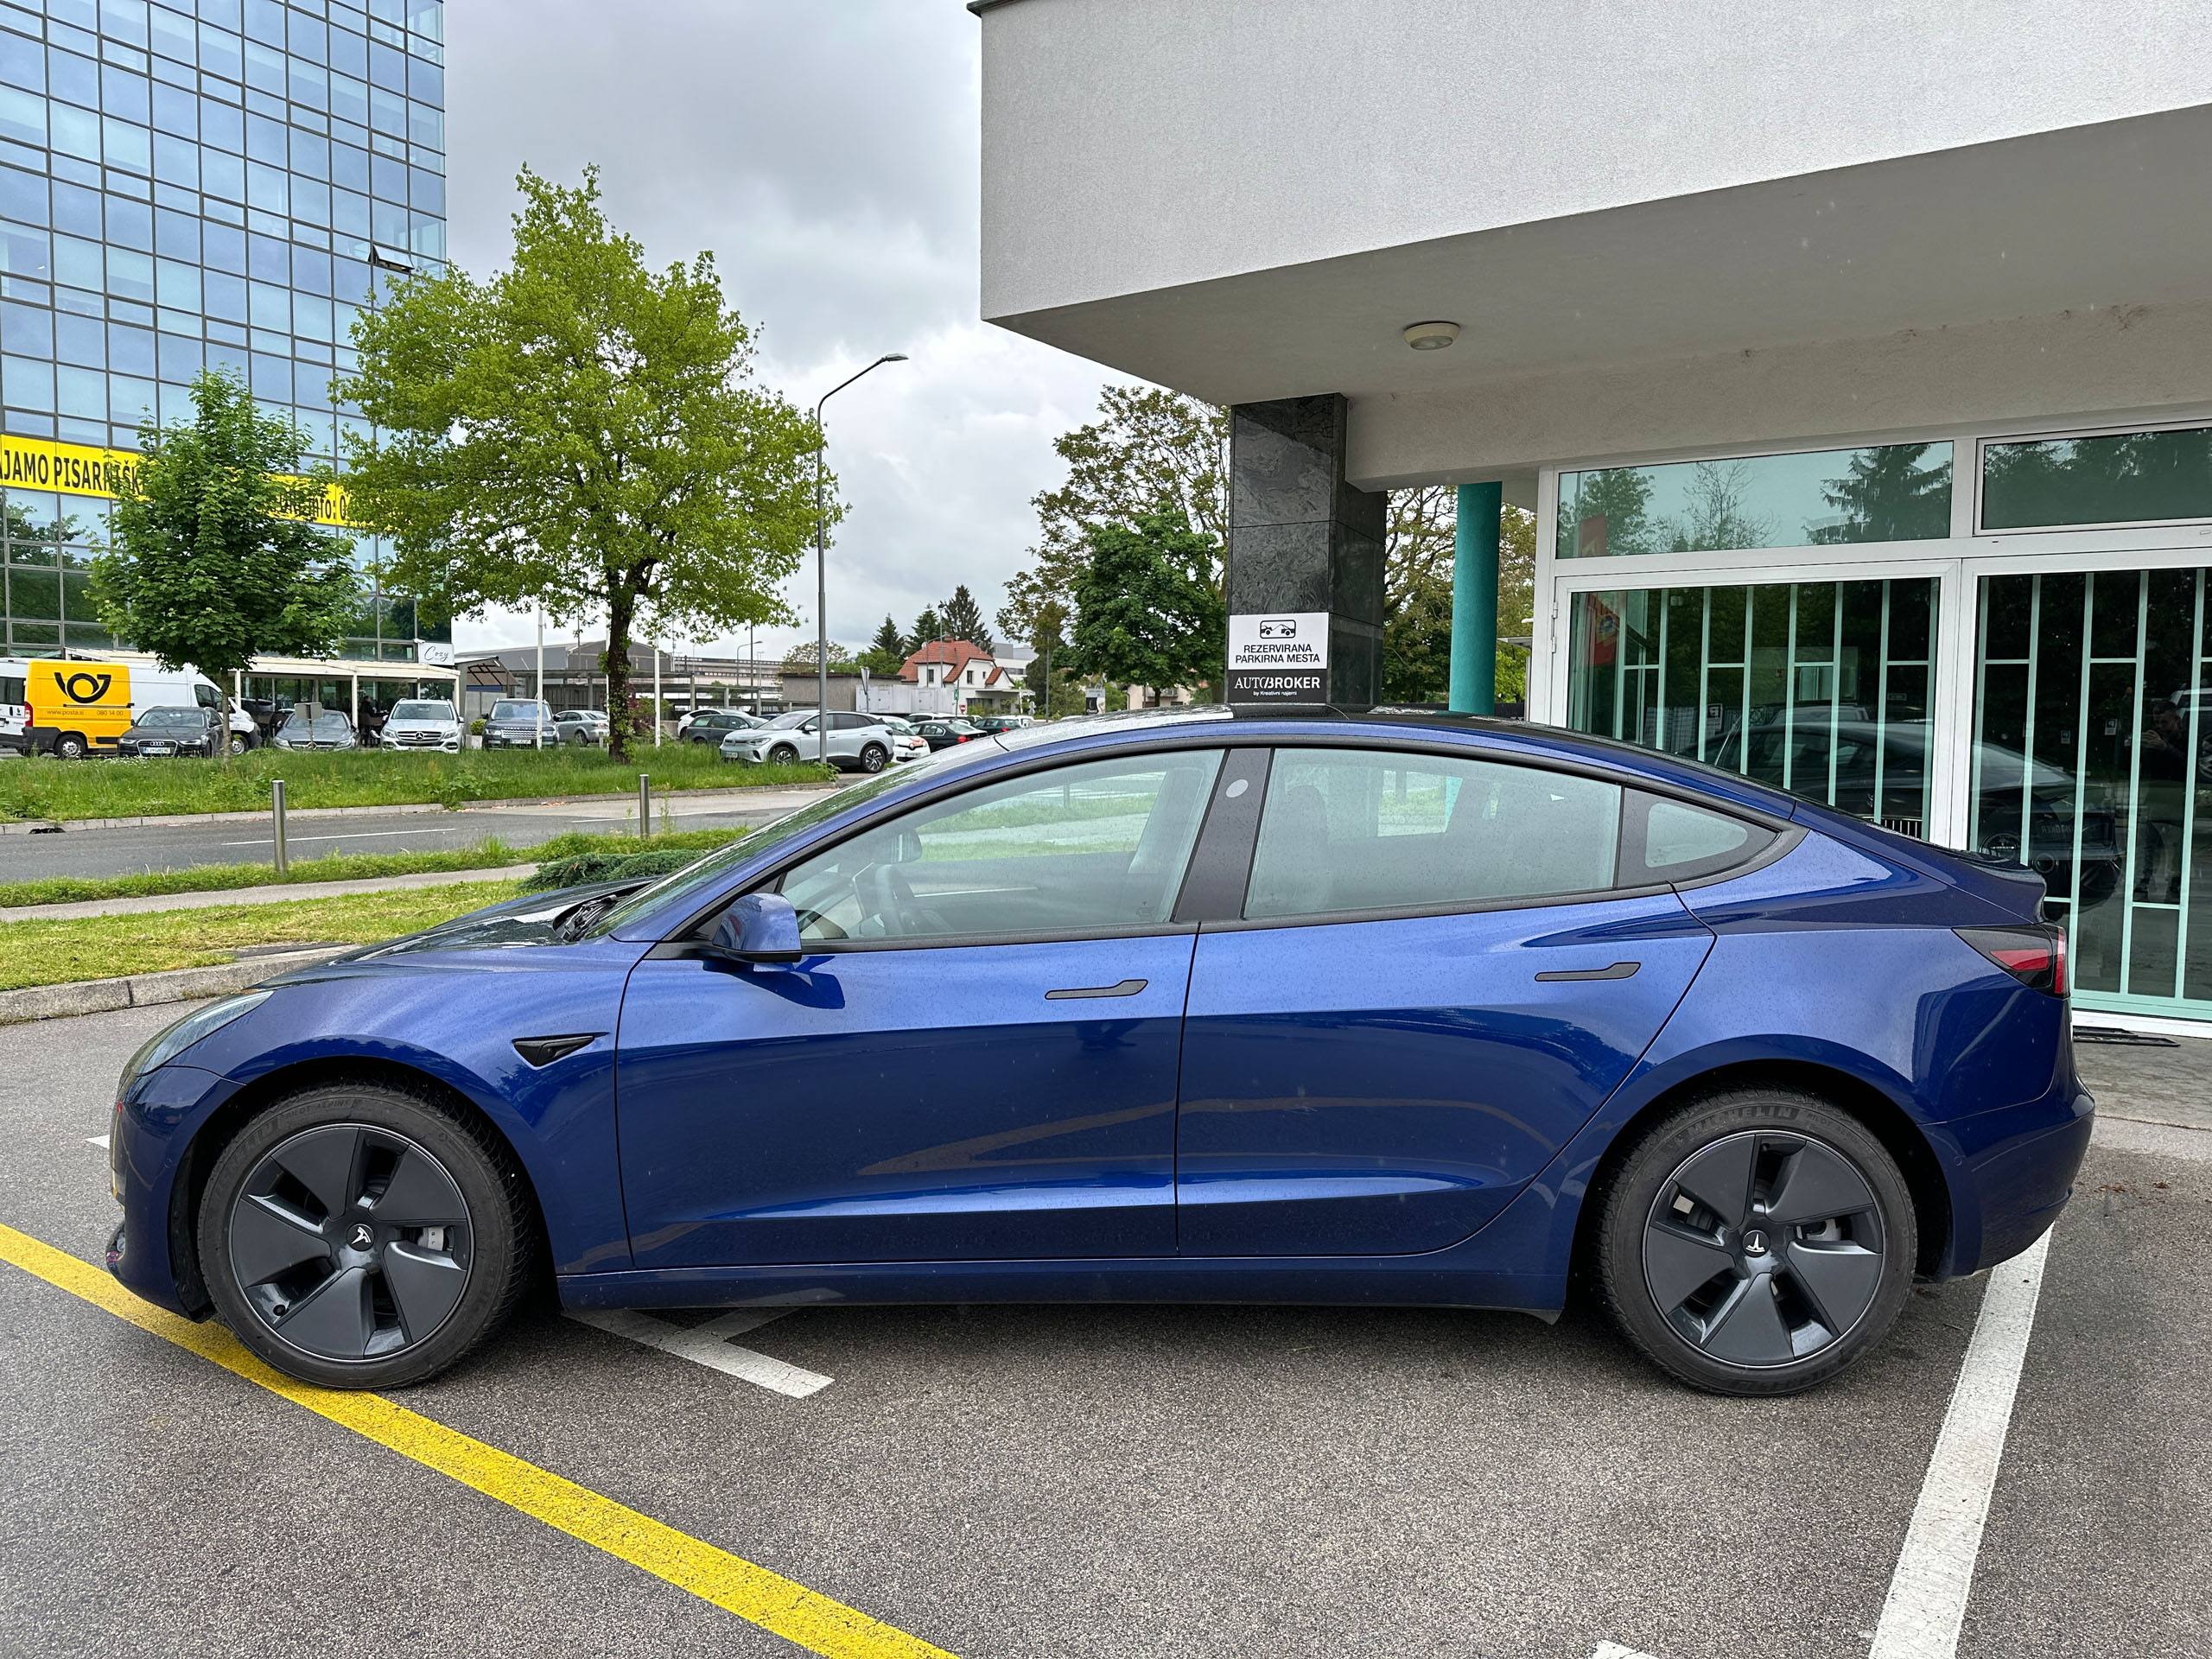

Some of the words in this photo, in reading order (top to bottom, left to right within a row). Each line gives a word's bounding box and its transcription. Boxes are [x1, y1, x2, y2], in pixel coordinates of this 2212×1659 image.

[0, 449, 48, 485] JAMO
[54, 456, 141, 496] PISARNIŠK
[424, 645, 448, 662] Cozy
[1243, 644, 1312, 653] REZERVIRANA
[1236, 654, 1283, 664] PARKIRNA
[1287, 653, 1320, 663] MESTA
